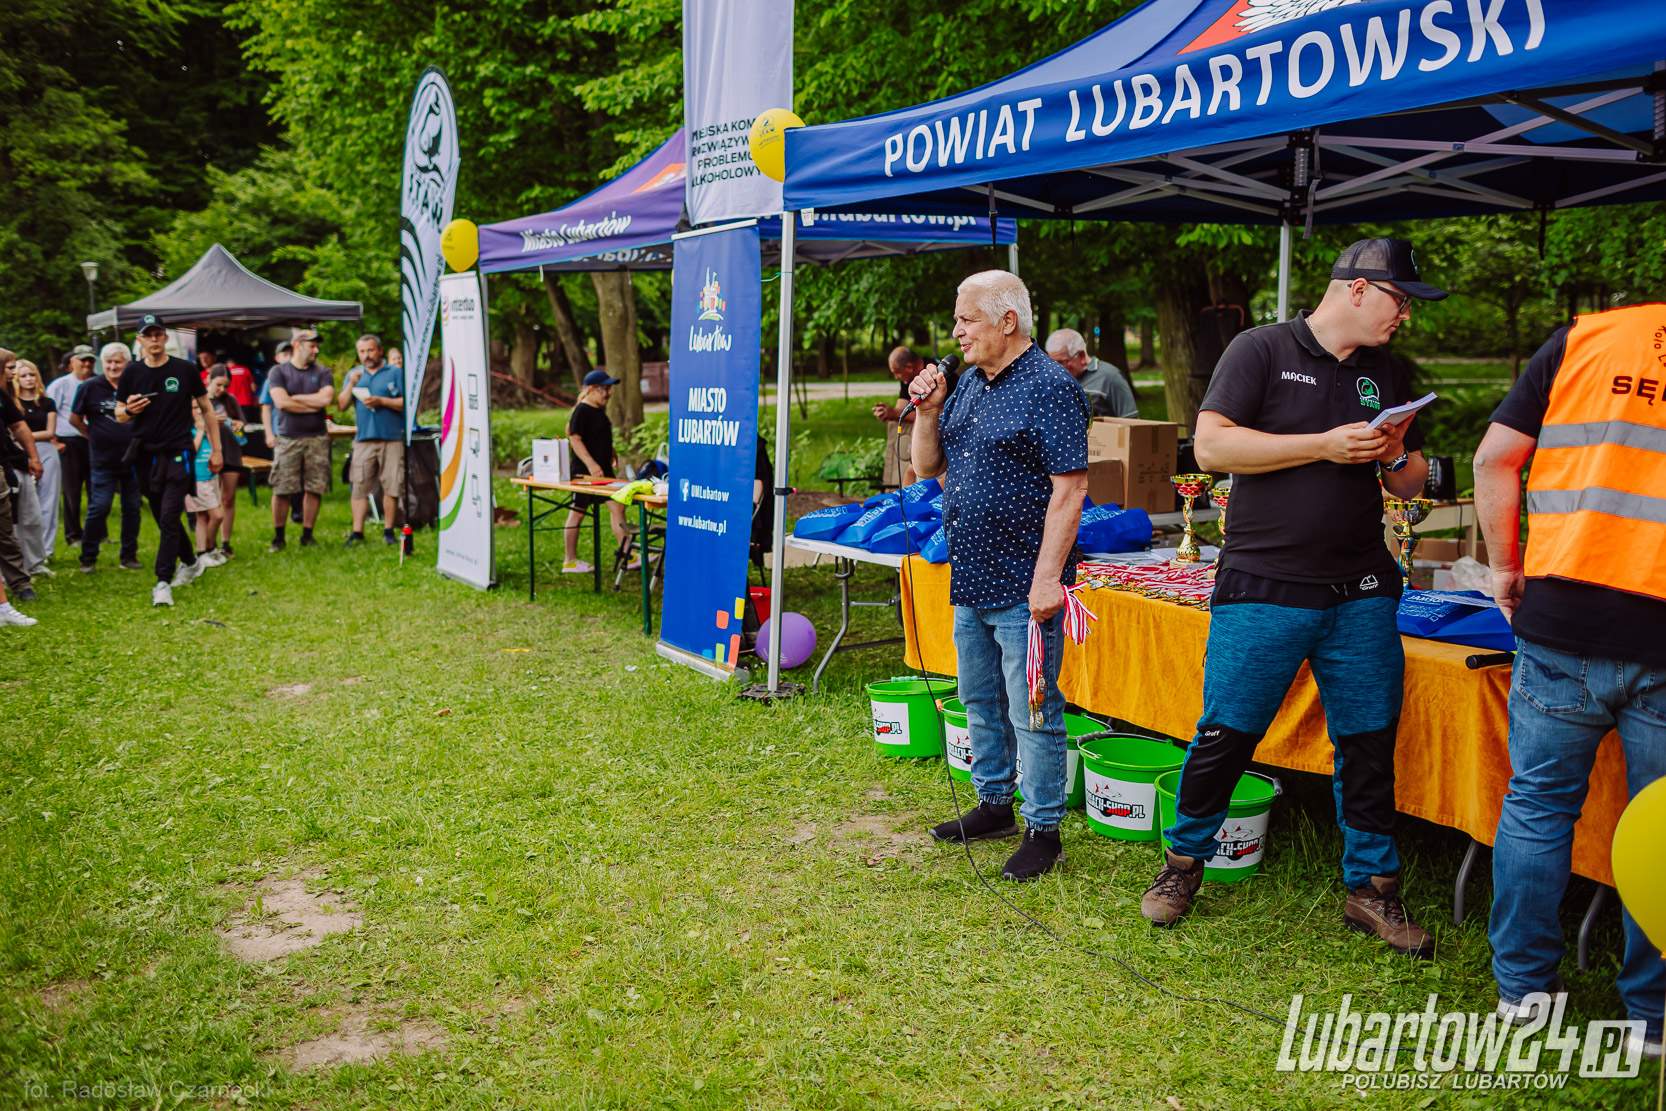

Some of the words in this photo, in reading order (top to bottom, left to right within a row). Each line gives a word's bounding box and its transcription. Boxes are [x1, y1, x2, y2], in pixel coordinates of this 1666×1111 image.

[884, 98, 1043, 177] POWIAT
[1066, 0, 1546, 143] LUBARTOWSKI
[521, 229, 565, 252] Miasto
[560, 211, 631, 246] Lubartów
[688, 324, 732, 352] Lubartów
[1281, 371, 1317, 386] MACIEK
[1611, 375, 1666, 406] SĘ
[687, 387, 727, 413] MIASTO
[678, 415, 740, 447] LUBARTÓW
